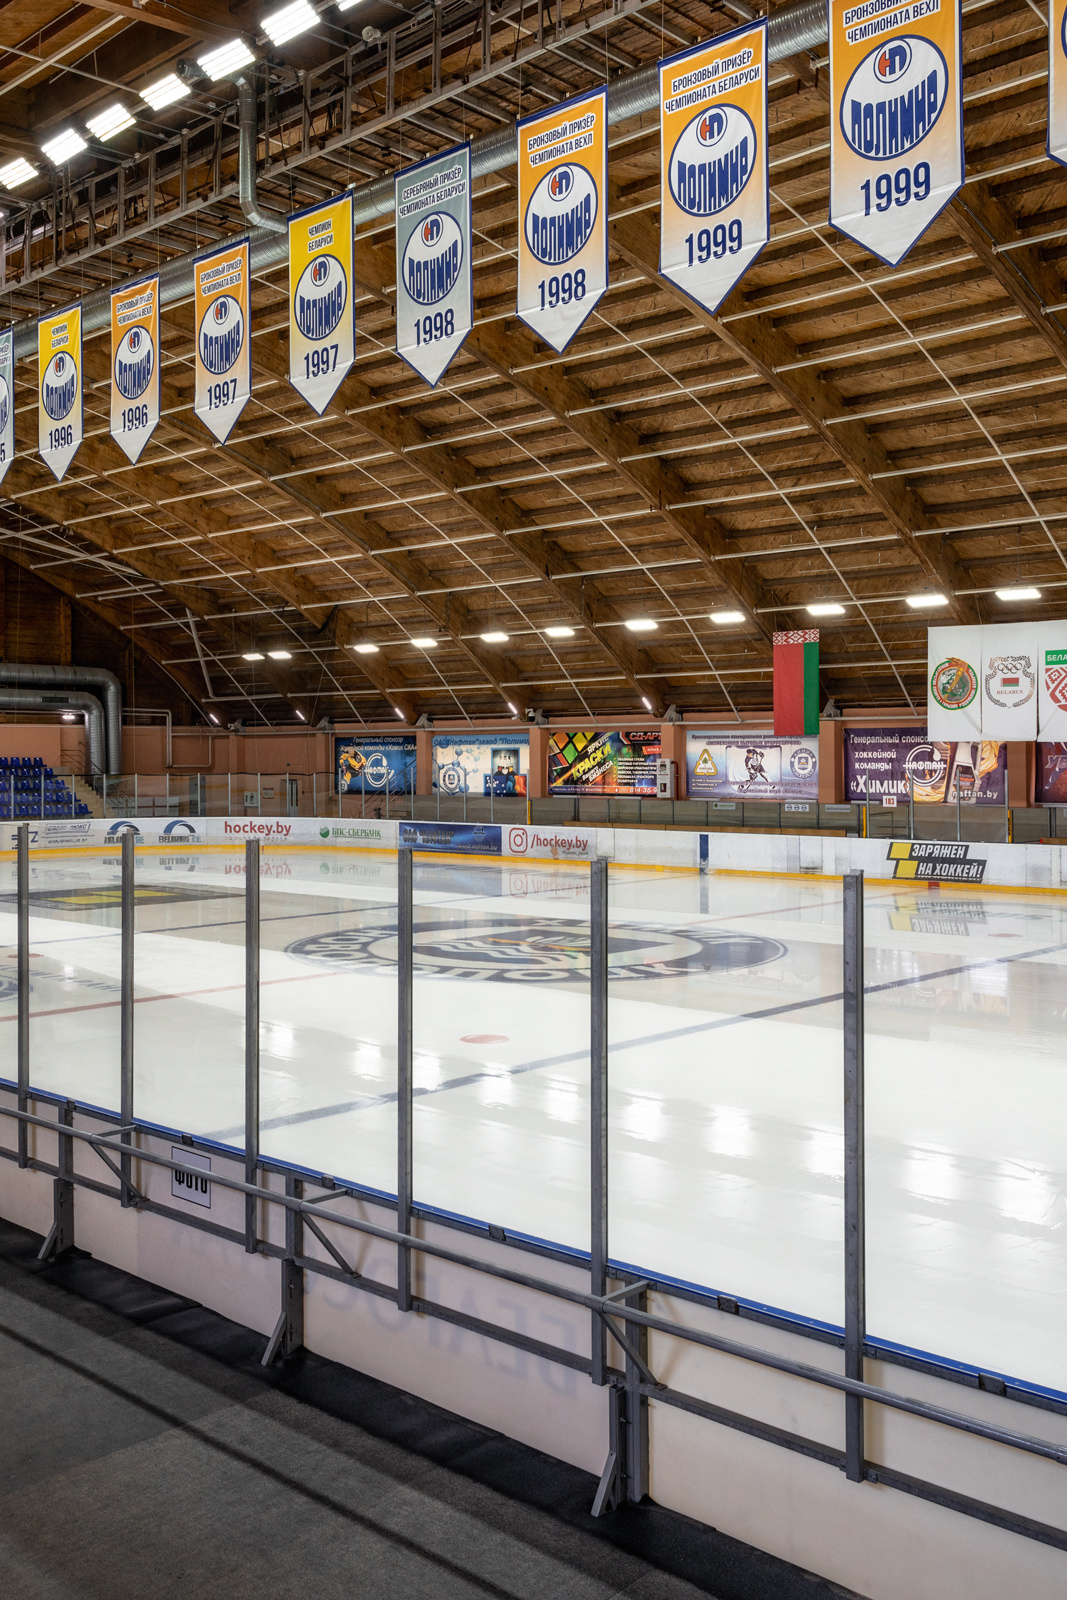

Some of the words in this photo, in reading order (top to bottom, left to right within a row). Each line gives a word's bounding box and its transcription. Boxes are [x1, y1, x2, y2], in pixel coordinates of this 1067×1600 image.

[847, 8, 911, 43] ЧЕМПИОНАТА
[912, 0, 939, 19] ВЕХЛ
[672, 61, 720, 93] БРОНЗОВЫЙ
[721, 49, 752, 74] ПРИЗЁР
[665, 84, 717, 113] ЧЕМПИОНАТА
[718, 66, 760, 93] БЕЛАРУСИ
[528, 123, 568, 151] БРОНЗОВЫЙ
[568, 114, 595, 135] ПРИЗЁР
[530, 144, 574, 167] ЧЕМПИОНАТА
[574, 133, 593, 151] ВЕХЛ
[399, 196, 436, 217] ЧЕМПИОНАТА
[436, 182, 466, 203] БЕЛАРУСИ
[403, 175, 439, 201] СЕРЕБРЯНЫЙ
[439, 166, 462, 185] ПРИЗЁР
[860, 161, 931, 217] 1999
[308, 219, 332, 237] ЧЕМПИОН
[308, 233, 333, 252] БЕЛАРУСИ
[685, 218, 742, 267] 1999
[538, 268, 586, 311] 1998
[414, 308, 455, 348] 1998
[304, 344, 339, 379] 1997
[207, 378, 237, 411] 1997
[121, 403, 148, 433] 1996
[49, 424, 73, 451] 1996
[588, 733, 610, 755] ЯРКИЕ
[850, 734, 900, 745] Генеральный
[901, 735, 931, 745] спонсо
[854, 749, 897, 759] хоккейной
[572, 742, 612, 780] КРАСКИ
[589, 760, 613, 782] БИЗНЕСА
[854, 762, 892, 771] команды
[224, 821, 291, 836] hockey.by
[332, 827, 381, 838] БПС-СБЕРБАНК
[911, 844, 965, 859] ЗАРЯЖЕН
[917, 863, 933, 875] НА
[934, 863, 983, 878] ХОККЕЙ!
